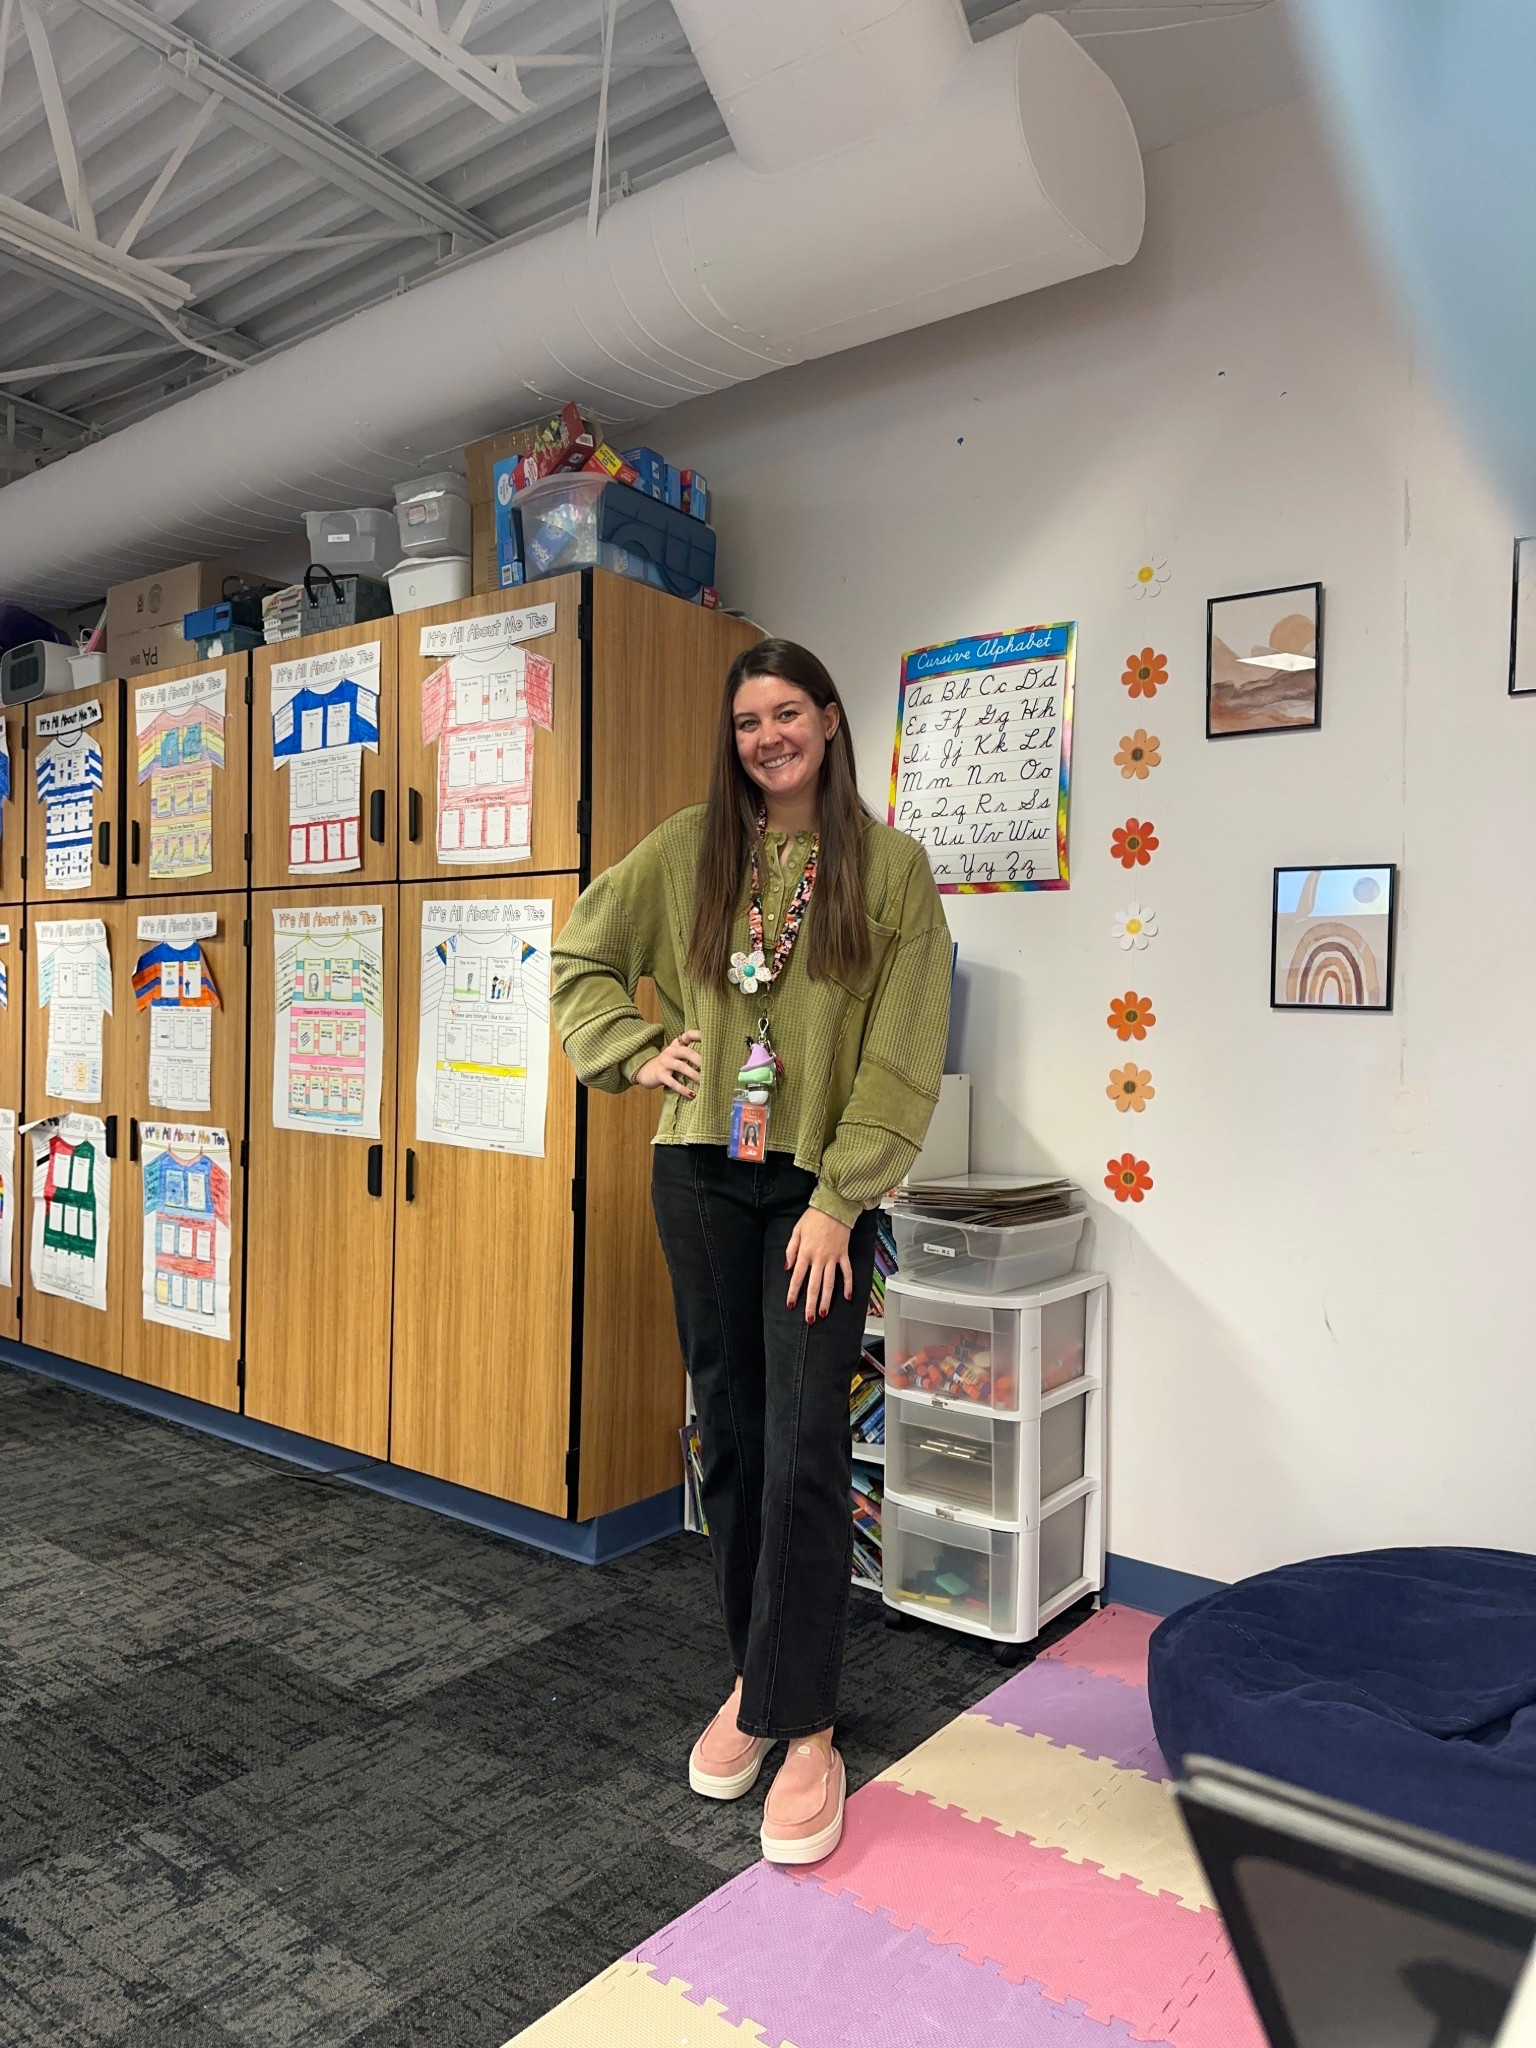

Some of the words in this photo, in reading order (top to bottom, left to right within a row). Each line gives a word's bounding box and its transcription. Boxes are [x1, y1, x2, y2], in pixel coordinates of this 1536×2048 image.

[426, 631, 447, 648] It's
[450, 627, 465, 645] All
[466, 620, 502, 642] About
[503, 616, 523, 635] Me
[526, 612, 548, 629] Tee
[917, 650, 971, 670] Cursive
[977, 630, 1051, 662] Alphabet
[276, 667, 293, 684] It's
[295, 661, 307, 680] All
[310, 657, 338, 677] About
[339, 653, 355, 670] Me
[357, 649, 374, 664] Tee
[140, 692, 155, 706] It's
[156, 688, 166, 703] All
[168, 683, 190, 701] About
[192, 680, 205, 695] Me
[206, 677, 221, 690] Tee
[39, 719, 50, 731] It's
[51, 716, 59, 729] All
[60, 712, 77, 727] About
[79, 709, 87, 722] Me
[87, 706, 98, 718] Tee
[278, 912, 296, 928] It's
[298, 912, 311, 928] All
[313, 911, 341, 927] About
[342, 910, 358, 927] Me
[359, 910, 377, 926] Tee
[428, 906, 447, 922] It's
[450, 904, 464, 922] All
[466, 904, 500, 922] About
[502, 904, 521, 922] Me
[524, 905, 545, 921] Tee
[145, 1126, 160, 1140] It's
[162, 1126, 172, 1141] All
[173, 1128, 196, 1143] About
[198, 1130, 211, 1145] Me
[212, 1132, 225, 1146] Tee
